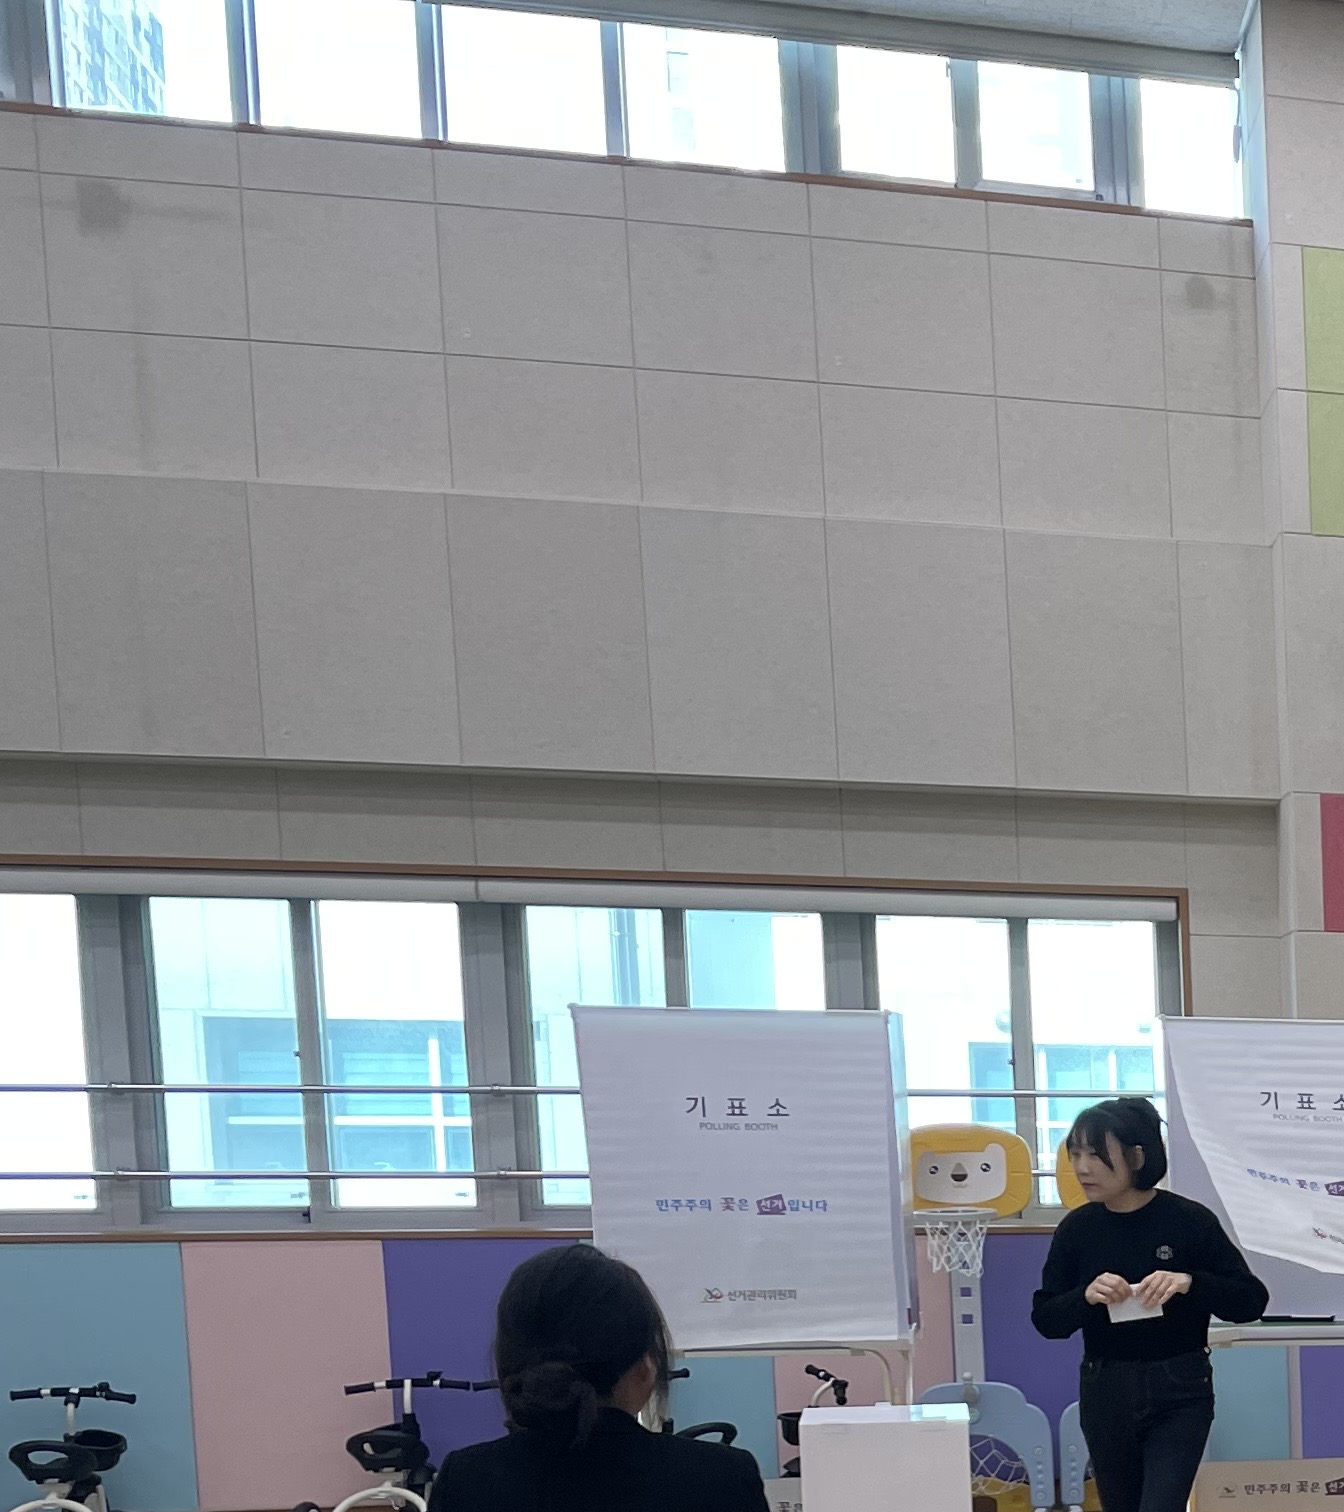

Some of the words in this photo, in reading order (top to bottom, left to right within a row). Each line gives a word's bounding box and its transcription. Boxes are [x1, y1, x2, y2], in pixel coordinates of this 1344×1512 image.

[699, 1121, 740, 1130] POLLING
[744, 1122, 778, 1130] BOOTH
[655, 1198, 711, 1211] 민주주의
[719, 1196, 749, 1211] 꽃은
[1243, 1482, 1290, 1495] 민주주의
[1295, 1480, 1320, 1493] 꽃은
